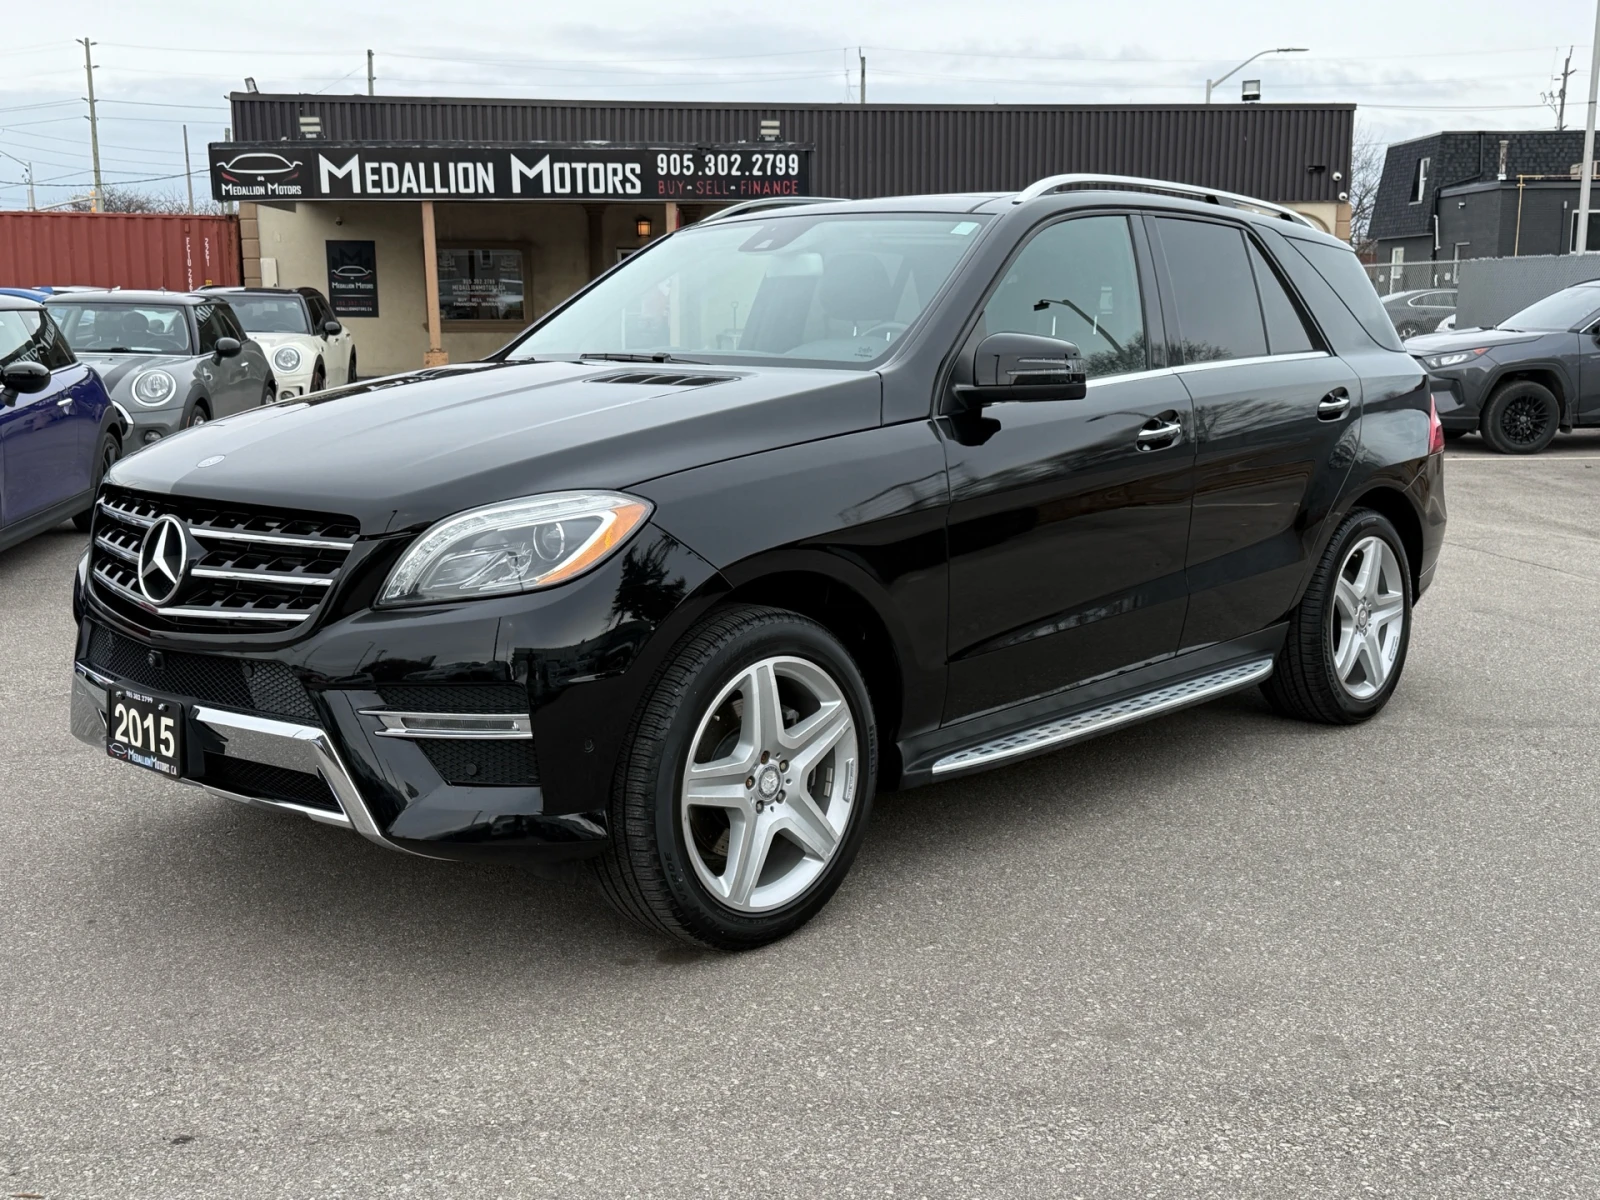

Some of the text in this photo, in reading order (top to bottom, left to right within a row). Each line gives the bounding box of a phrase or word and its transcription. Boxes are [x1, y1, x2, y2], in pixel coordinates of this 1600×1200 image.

[318, 153, 642, 194] MEDALLION MOTORS
[657, 153, 799, 176] 905.302.2799
[221, 183, 302, 195] MEDALLION MOTORS
[740, 180, 799, 195] FINANCE
[115, 703, 174, 757] 2015
